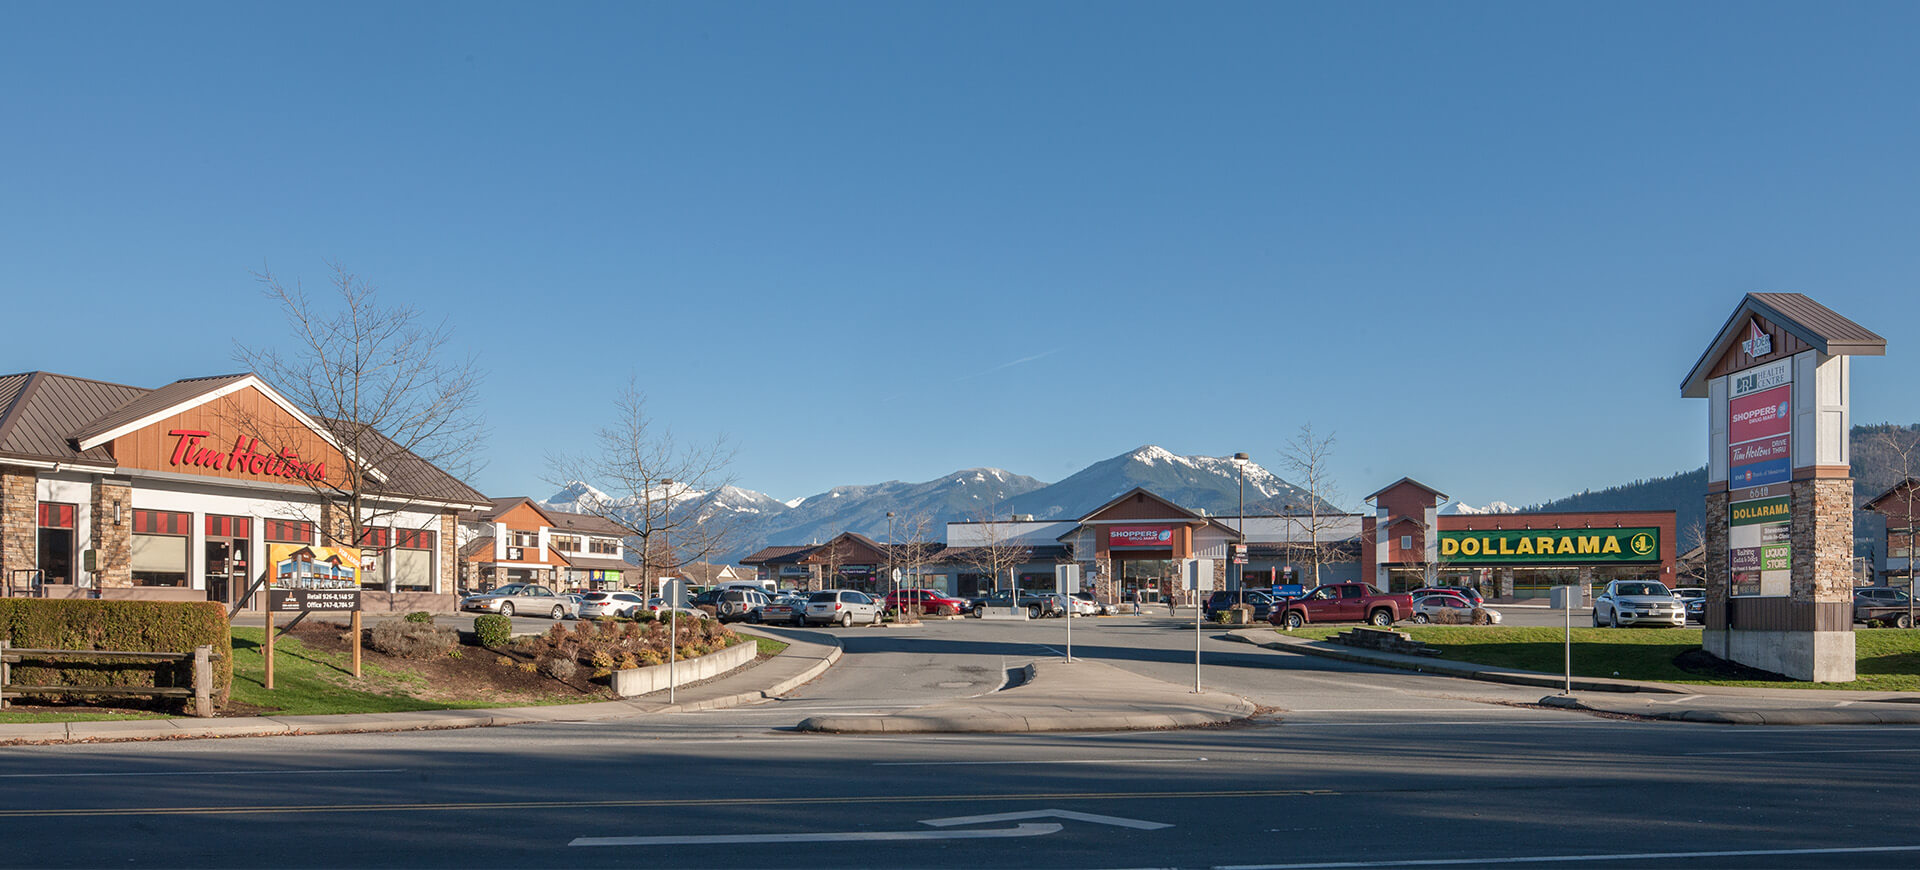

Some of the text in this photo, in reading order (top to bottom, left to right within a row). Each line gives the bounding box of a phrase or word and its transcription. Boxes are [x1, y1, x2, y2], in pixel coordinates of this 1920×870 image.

[1743, 335, 1769, 351] VEDDER
[1757, 365, 1785, 379] HEALTH
[1757, 374, 1785, 389] CENTRE
[1733, 405, 1776, 422] SHOPPERS
[1763, 414, 1776, 422] MART
[1771, 438, 1787, 448] DRIVE
[1772, 446, 1787, 455] THRU
[168, 430, 326, 481] Tim Hortons
[1732, 445, 1771, 461] Tim Hortons
[1734, 504, 1789, 519] DOLLARAMA
[1441, 535, 1622, 556] DOLLARAMA
[1765, 547, 1788, 559] LIQUOR
[338, 548, 348, 559] FOR
[346, 554, 360, 568] LEASE
[1766, 558, 1788, 569] STORE
